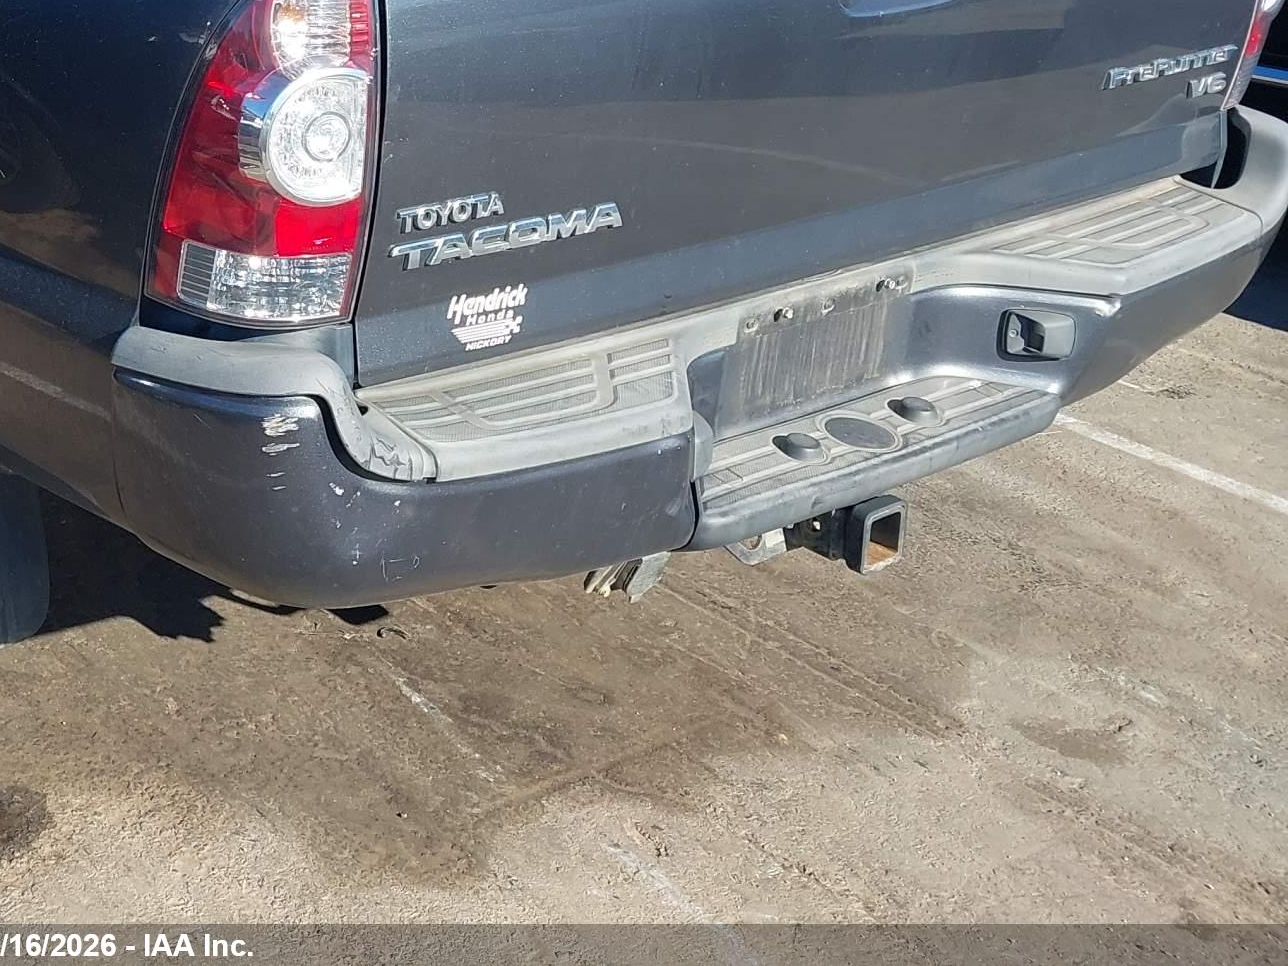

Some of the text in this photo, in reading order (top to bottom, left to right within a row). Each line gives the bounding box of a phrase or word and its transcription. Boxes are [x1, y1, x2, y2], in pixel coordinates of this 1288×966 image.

[1186, 71, 1227, 98] V6
[396, 191, 505, 234] TOYOTA
[388, 201, 623, 271] TACOMA
[446, 283, 528, 325] Hendrick
[465, 309, 515, 326] Honda
